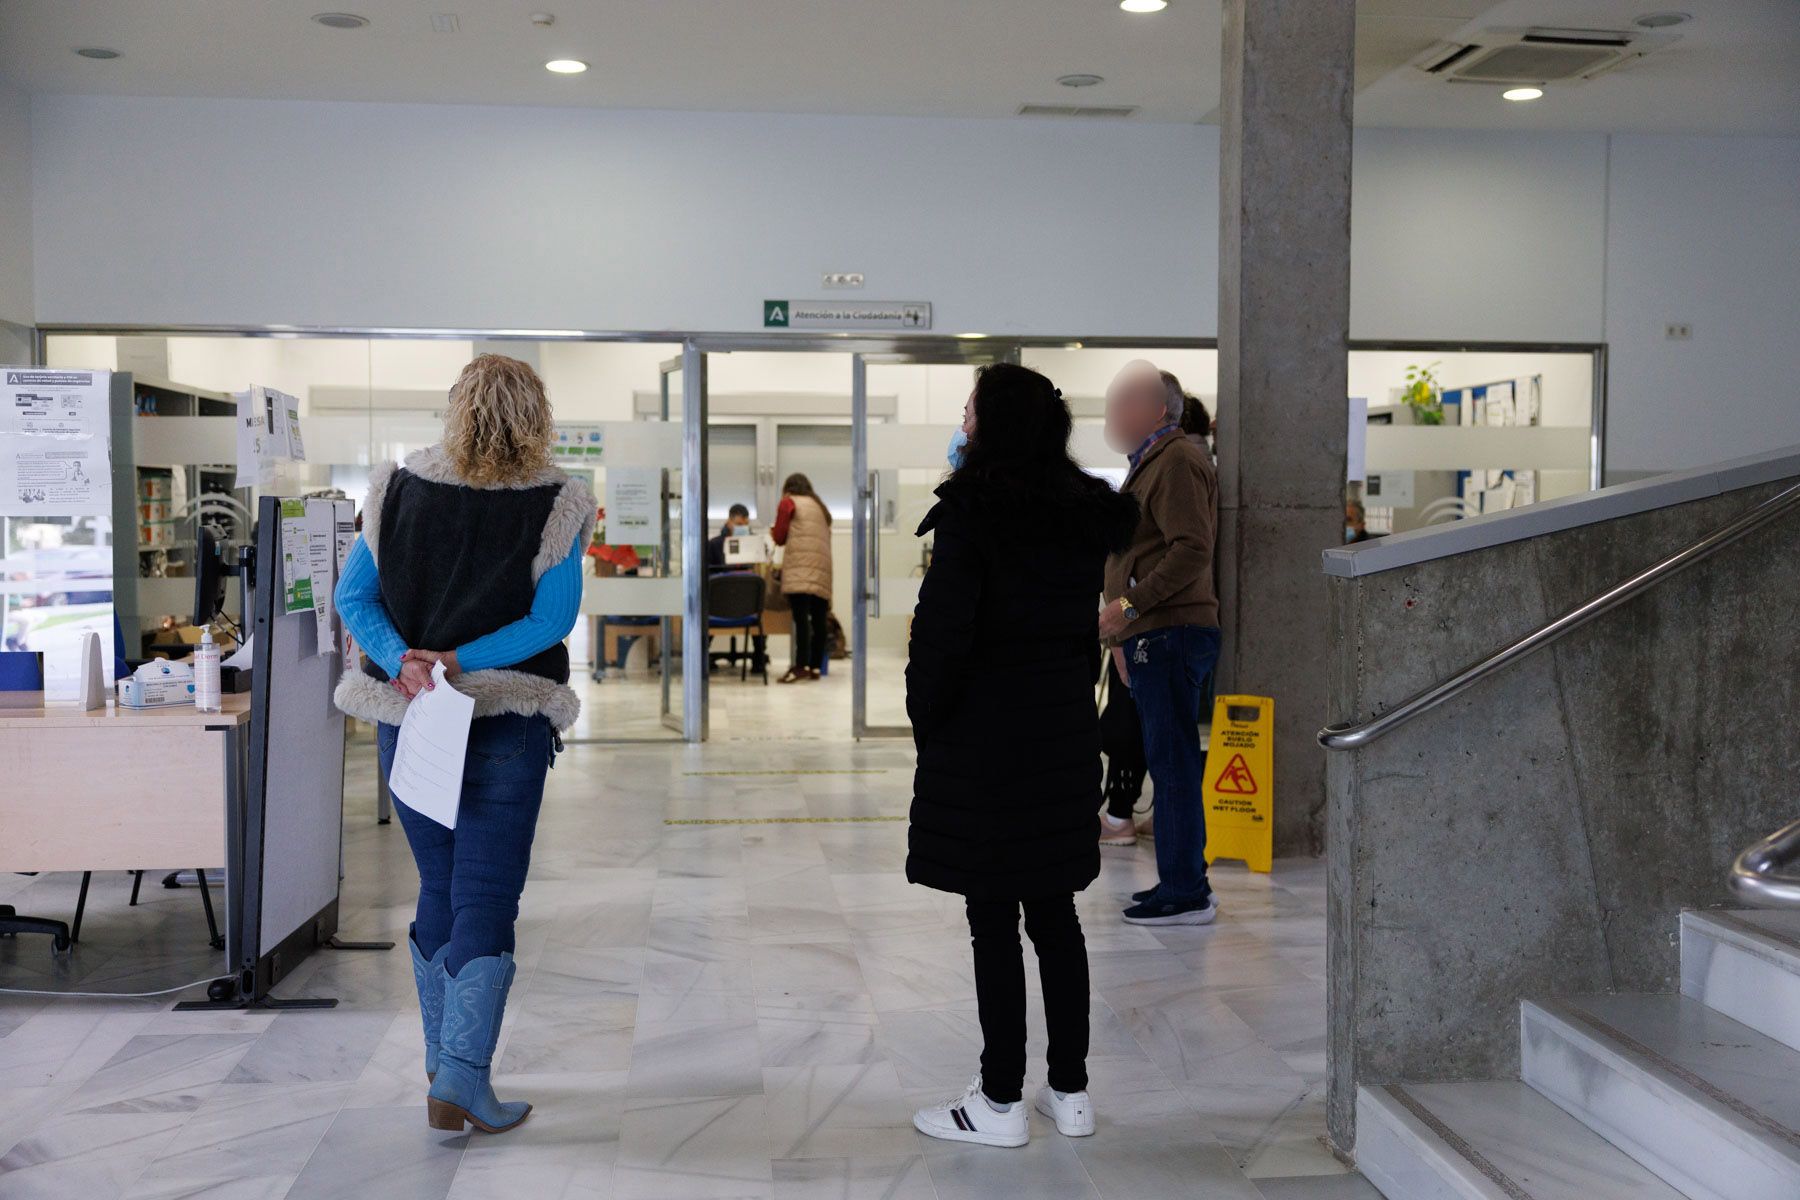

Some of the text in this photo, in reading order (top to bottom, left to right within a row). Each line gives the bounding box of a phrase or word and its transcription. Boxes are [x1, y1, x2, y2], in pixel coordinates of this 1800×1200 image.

[795, 310, 834, 319] Atención
[843, 311, 851, 319] la
[852, 310, 902, 320] Ciudadanía
